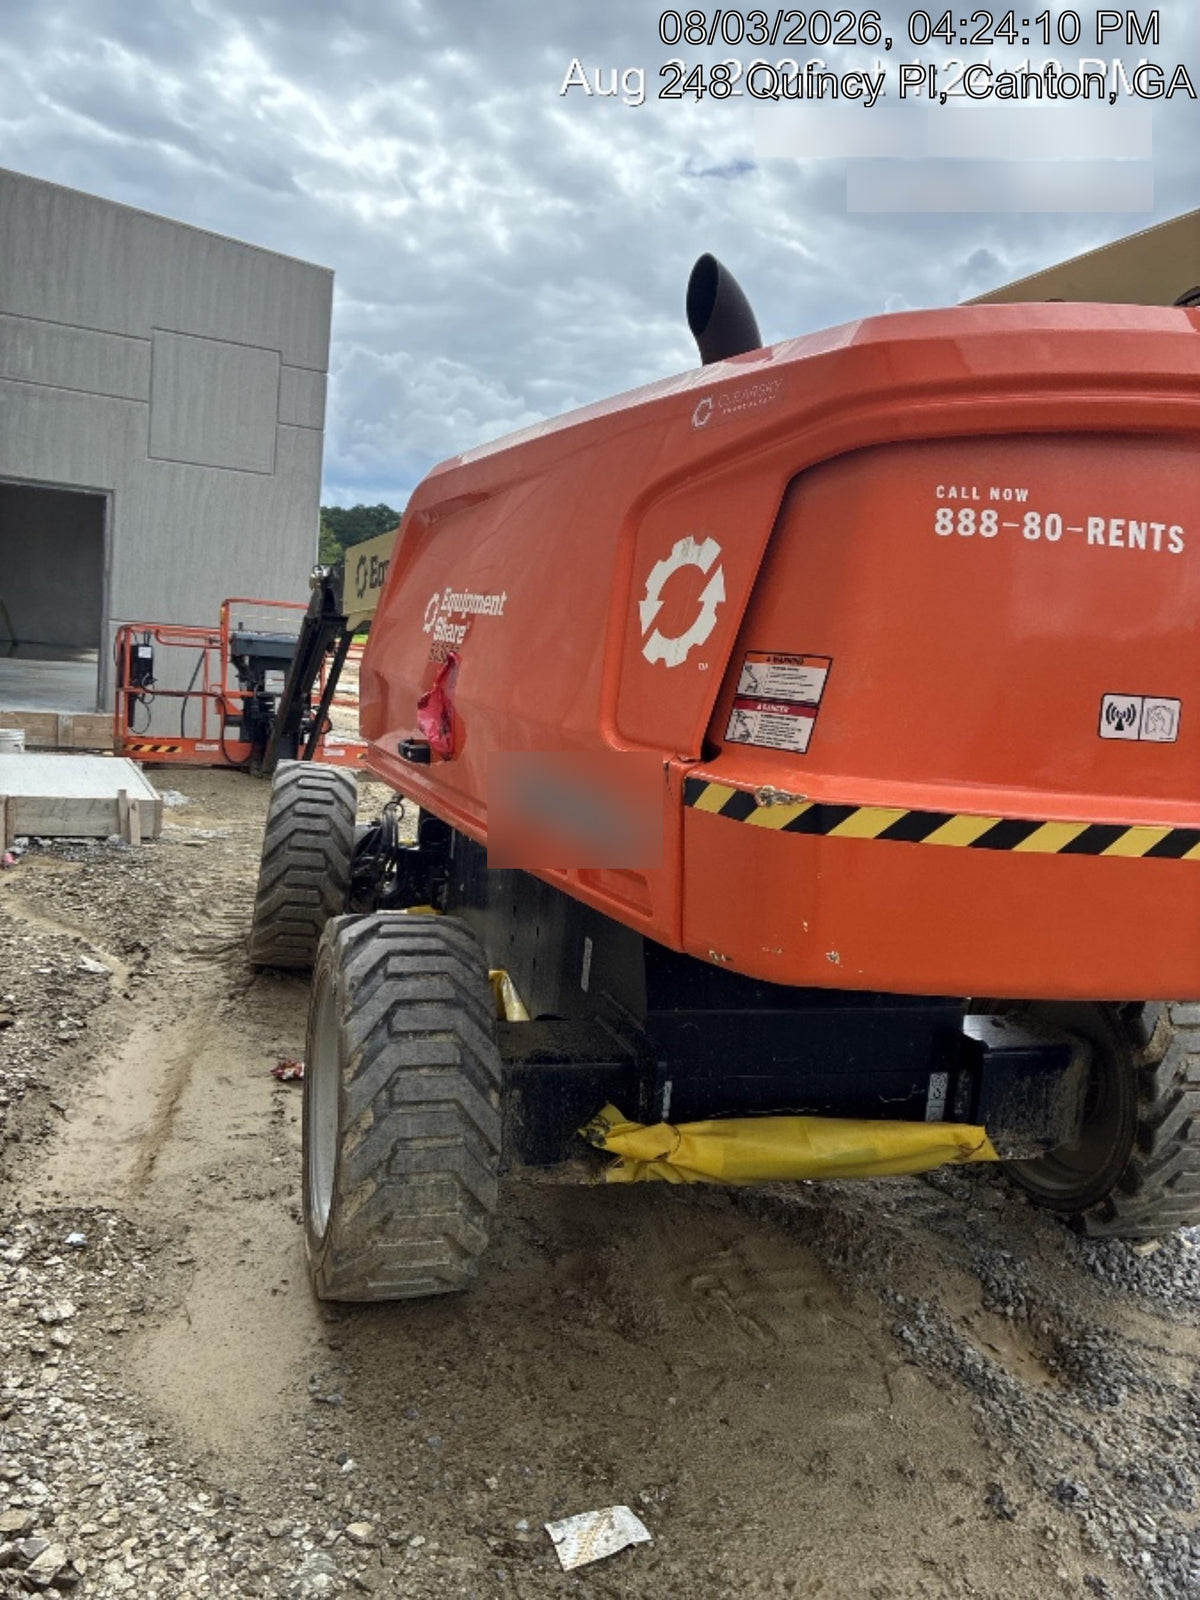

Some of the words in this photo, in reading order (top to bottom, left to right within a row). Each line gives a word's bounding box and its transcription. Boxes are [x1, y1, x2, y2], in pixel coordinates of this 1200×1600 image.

[936, 484, 980, 500] CALL
[989, 487, 1029, 503] NOW
[934, 507, 1185, 554] 888-80-RENTS
[440, 587, 507, 619] Equipment
[433, 616, 467, 645] Share
